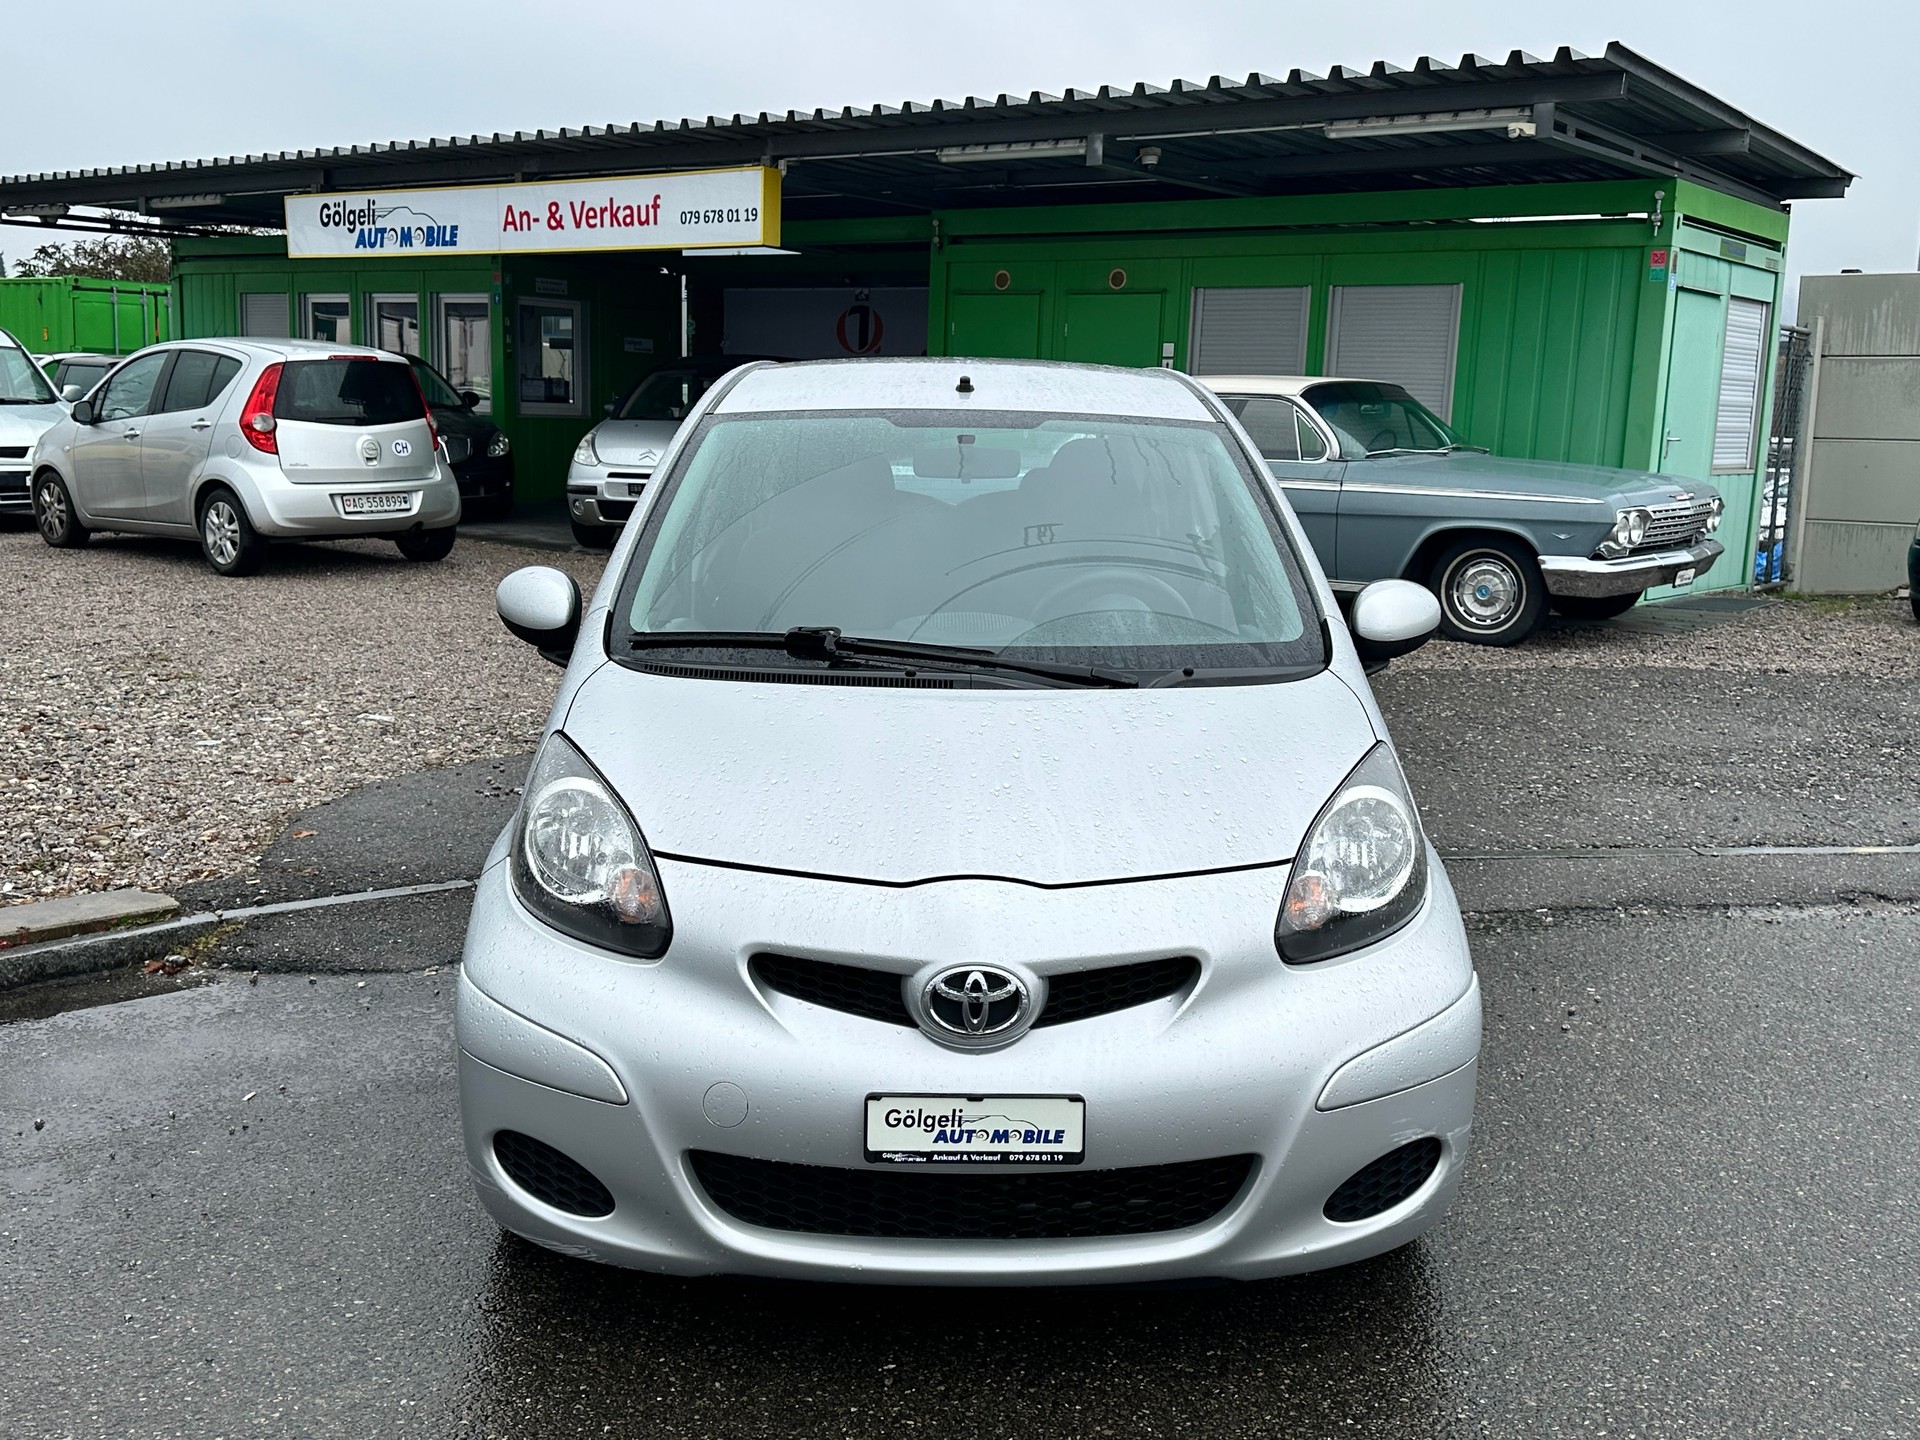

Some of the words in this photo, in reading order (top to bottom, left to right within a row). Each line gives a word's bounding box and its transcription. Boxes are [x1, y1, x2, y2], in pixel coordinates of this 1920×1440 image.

[319, 199, 376, 233] Gölgeli
[502, 204, 540, 232] An-
[546, 201, 565, 231] &
[569, 194, 661, 230] Verkauf
[680, 210, 700, 225] 079
[703, 209, 724, 224] 678
[727, 208, 741, 223] 01
[744, 207, 758, 222] 19
[394, 442, 409, 454] CH
[885, 1108, 964, 1133] Gölgeli
[932, 1153, 961, 1161] Ankauf
[970, 1153, 1001, 1161] Verkauf
